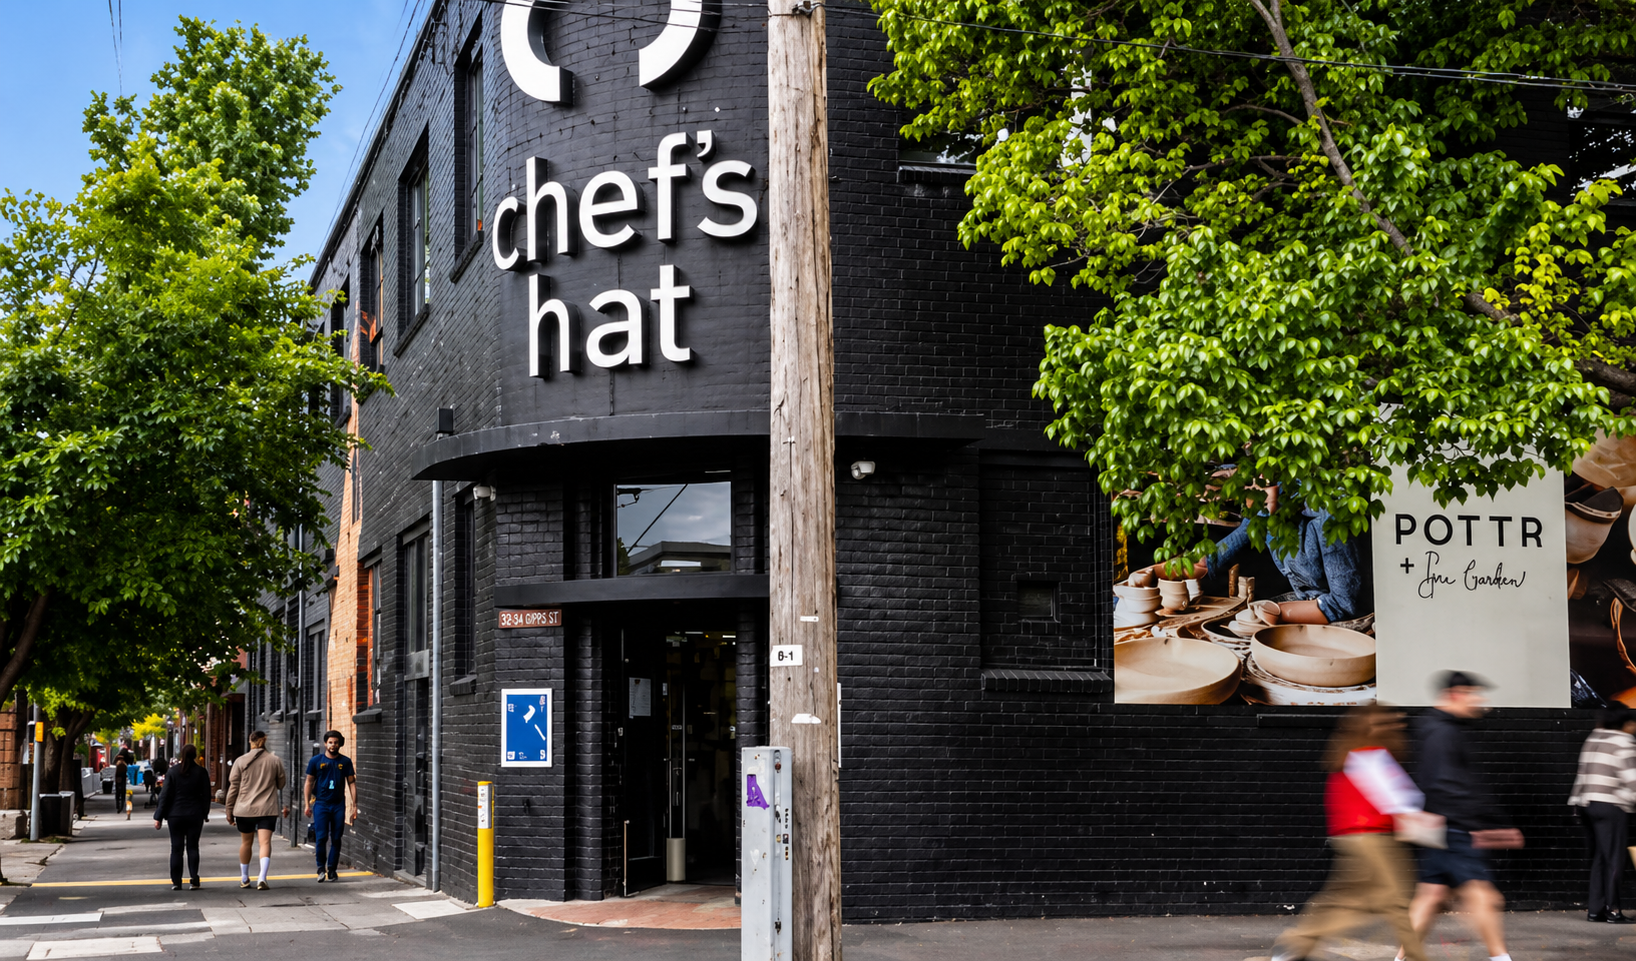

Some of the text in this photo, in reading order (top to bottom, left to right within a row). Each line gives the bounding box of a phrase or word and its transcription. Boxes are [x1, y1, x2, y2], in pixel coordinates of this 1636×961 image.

[529, 264, 692, 378] hat
[1395, 513, 1543, 548] POTTR
[525, 612, 547, 625] GIPPS
[548, 611, 559, 624] ST
